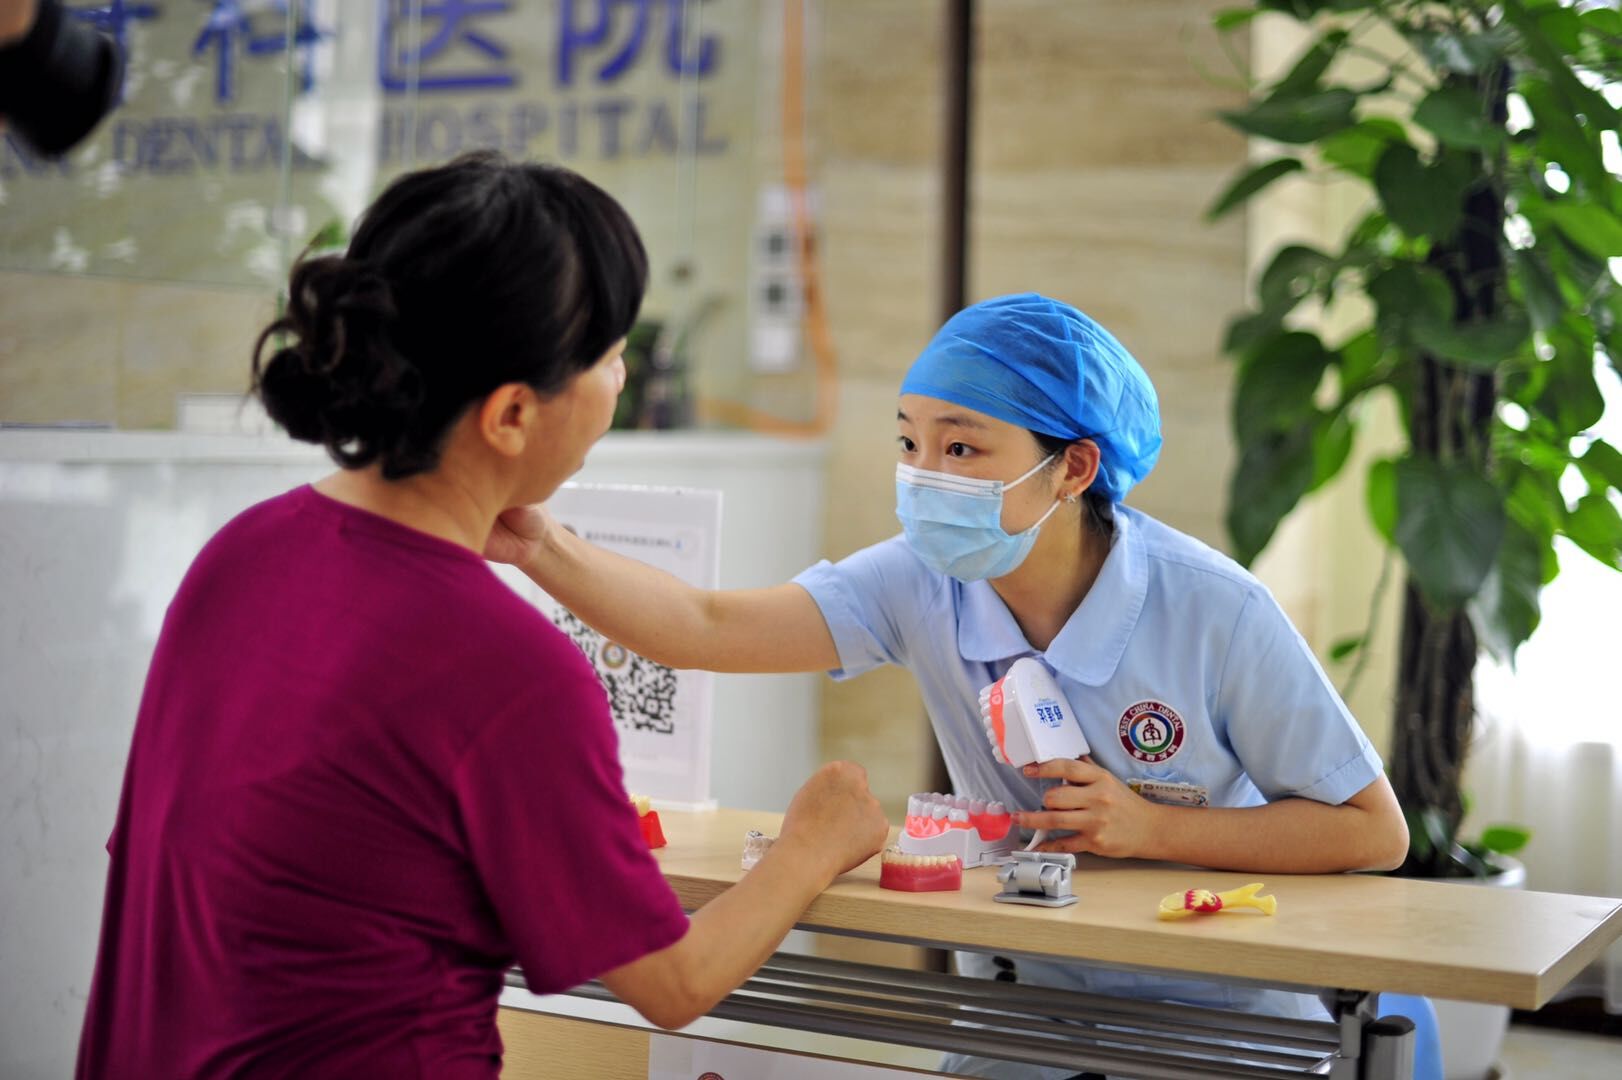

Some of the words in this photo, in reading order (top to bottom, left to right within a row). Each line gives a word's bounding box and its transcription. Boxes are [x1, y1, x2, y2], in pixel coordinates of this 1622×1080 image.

[380, 101, 729, 166] HOSPITAL
[1120, 716, 1130, 737] WEST
[1129, 703, 1155, 716] CHINA
[1158, 705, 1183, 732] DENTAL
